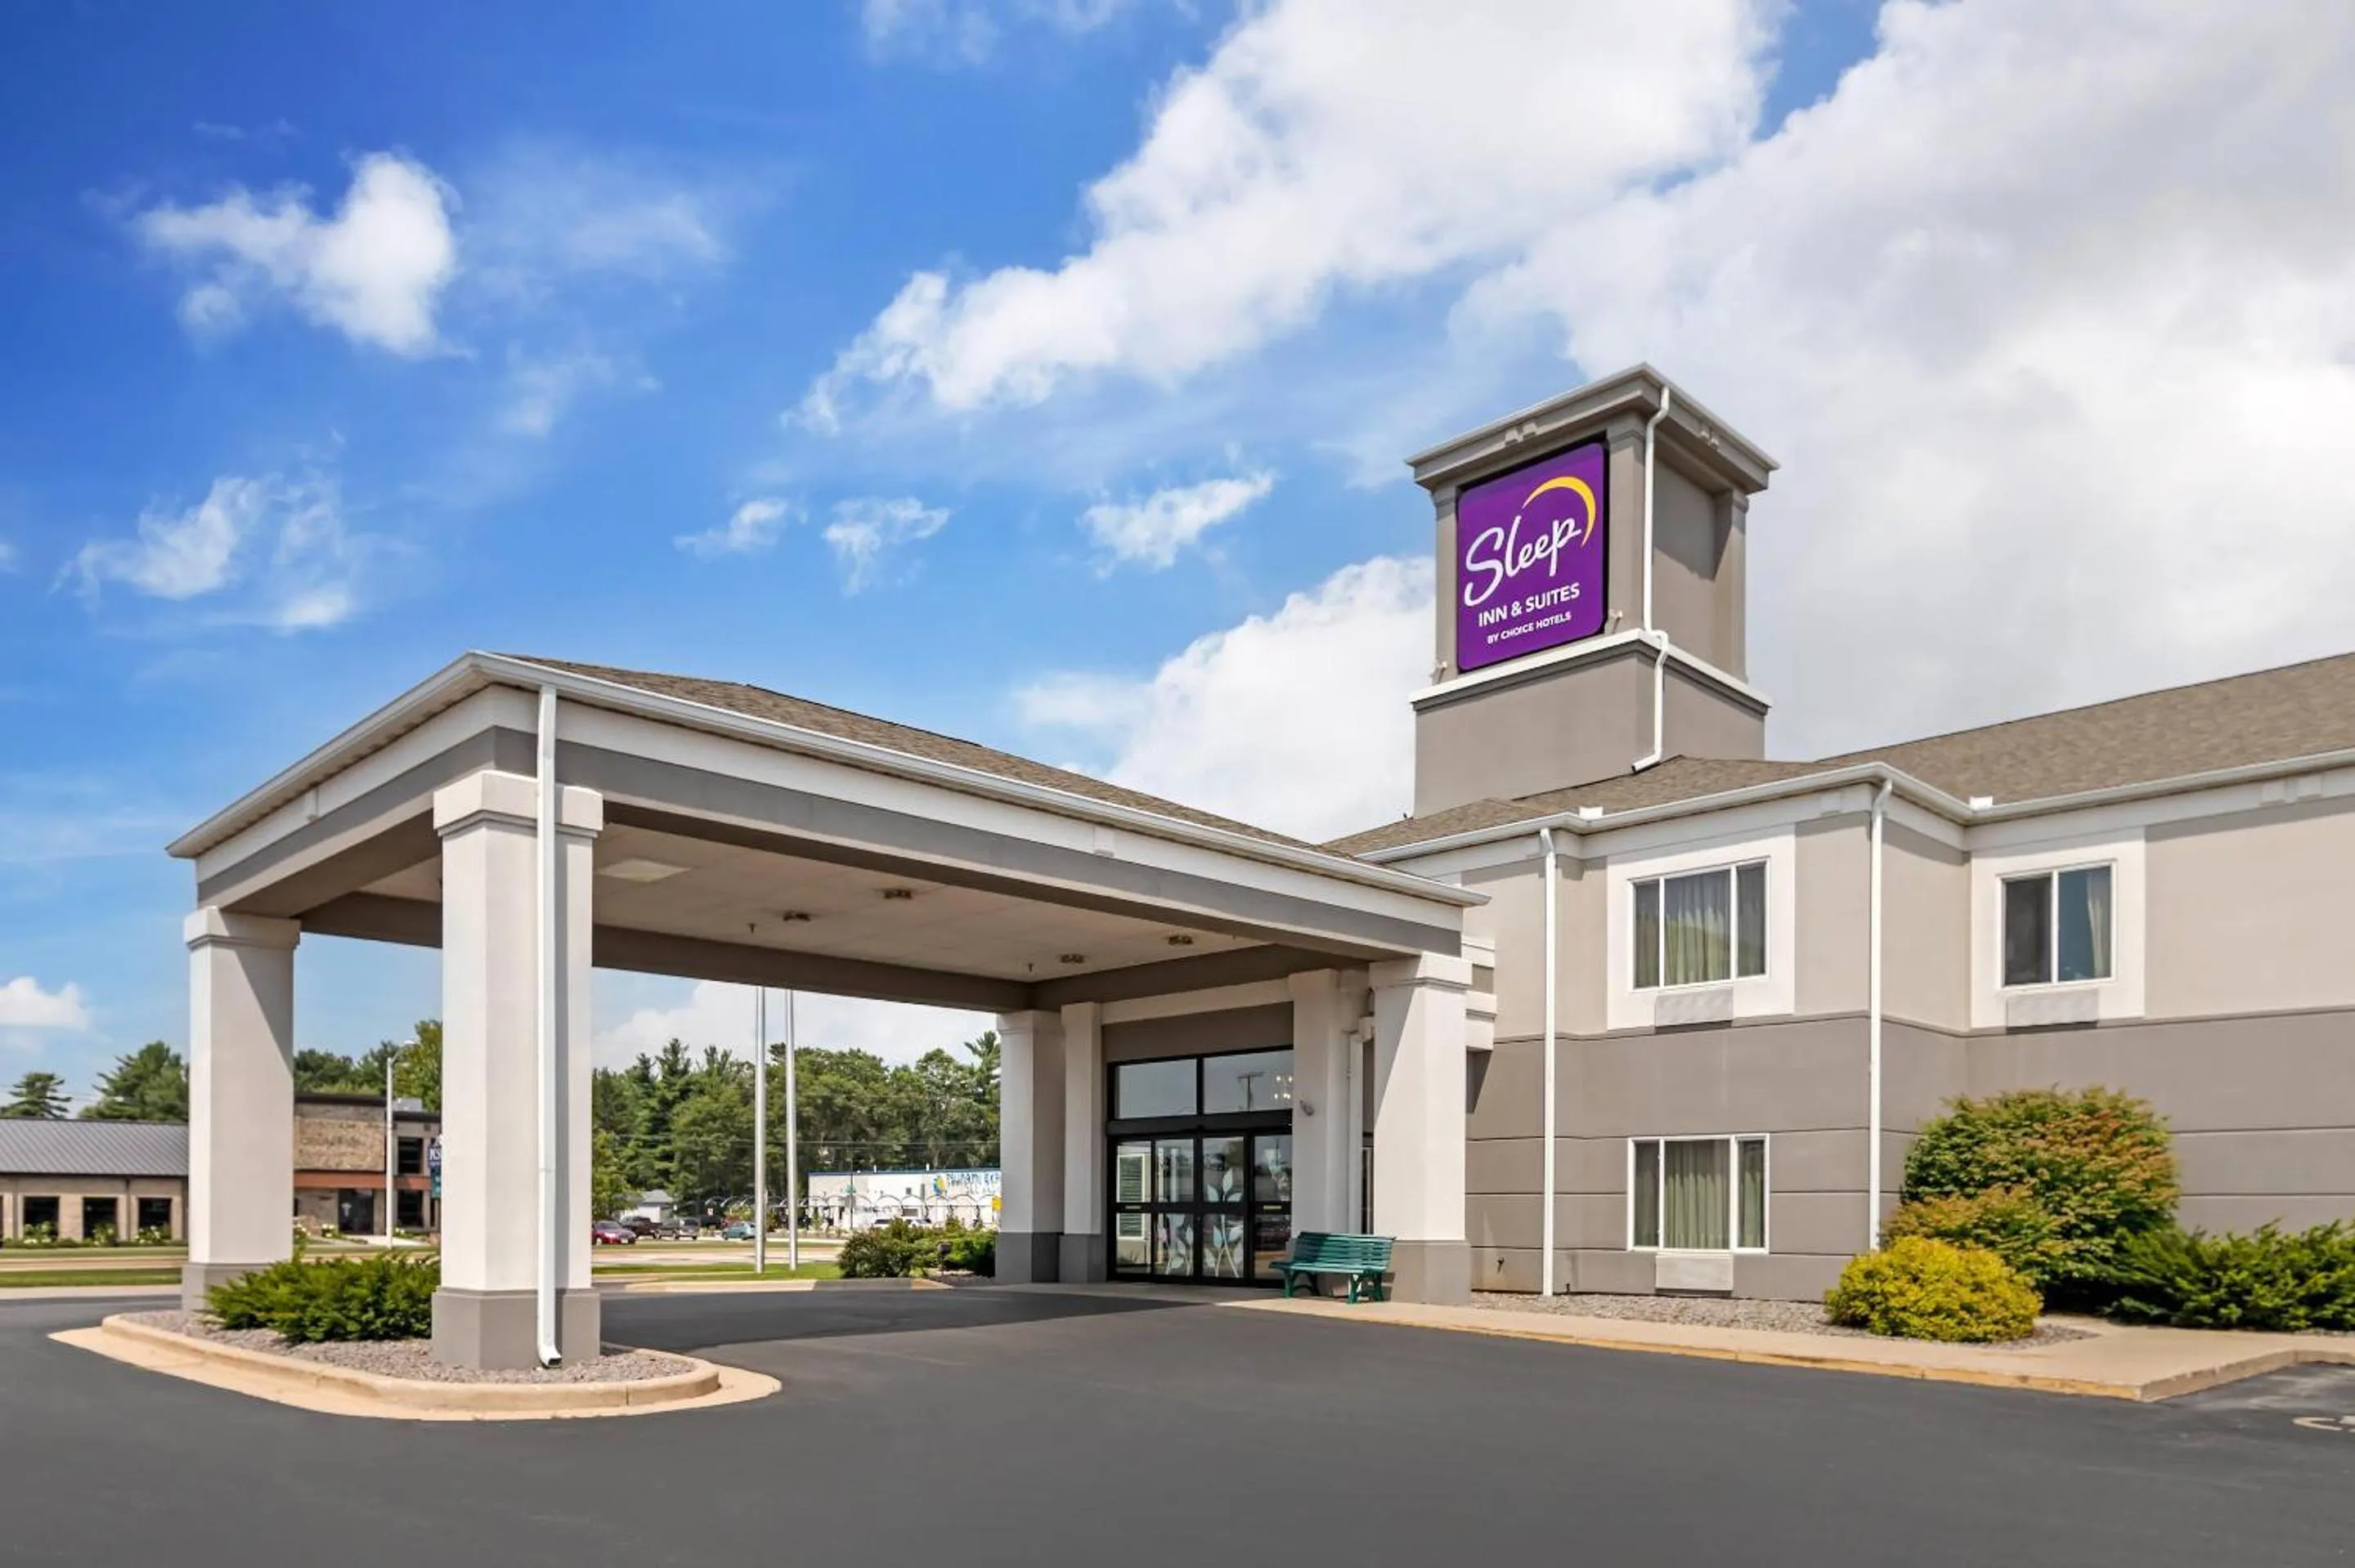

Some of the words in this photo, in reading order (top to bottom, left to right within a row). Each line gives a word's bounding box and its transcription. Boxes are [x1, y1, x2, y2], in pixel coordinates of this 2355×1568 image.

[1464, 515, 1582, 607] Sleep
[1478, 604, 1508, 627] INN
[1511, 600, 1522, 617] &
[1525, 581, 1581, 613] SUITES
[1487, 632, 1500, 644] BY
[1500, 622, 1535, 639] CHOICE
[1536, 611, 1572, 629] HOTELS
